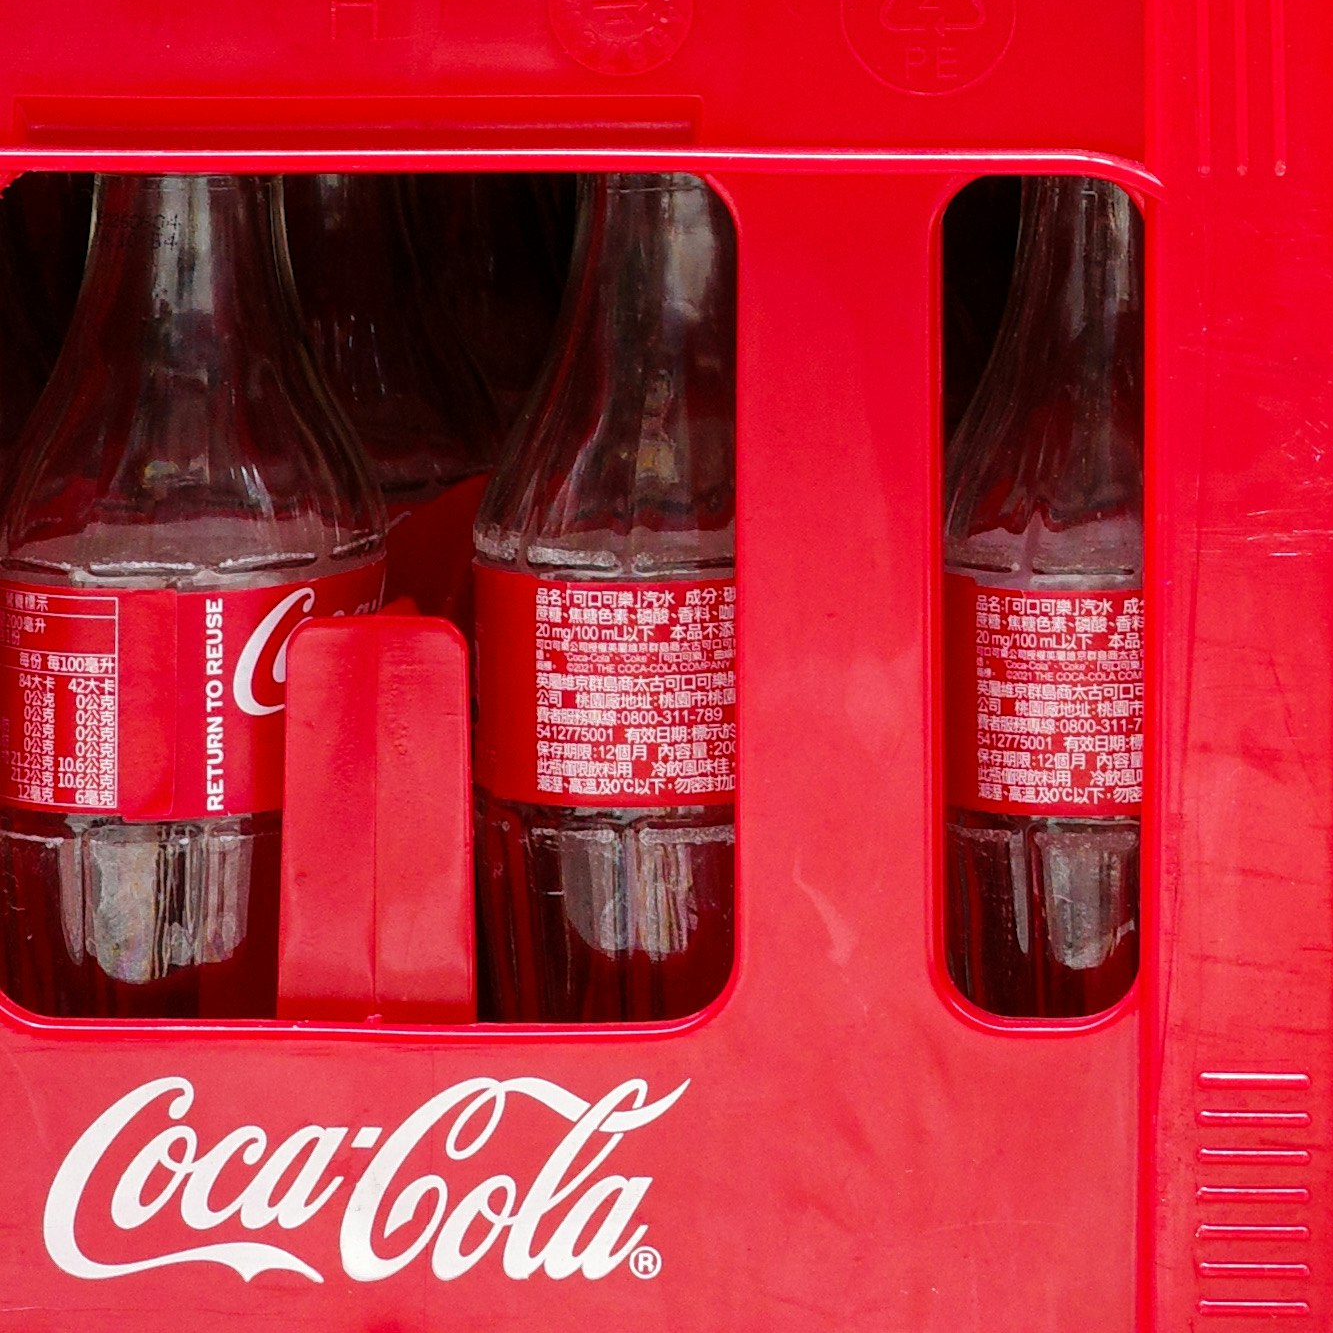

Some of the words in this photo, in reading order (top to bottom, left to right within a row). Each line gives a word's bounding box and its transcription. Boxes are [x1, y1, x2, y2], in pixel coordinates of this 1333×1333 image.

[205, 598, 223, 676] REUSE
[535, 623, 550, 638] 20
[552, 625, 599, 640] mg/100
[602, 625, 655, 642] mL以下
[976, 630, 990, 645] 20
[991, 633, 1037, 649] mg/100
[68, 677, 115, 694] 42大卡
[75, 693, 115, 711] 0公克
[205, 679, 224, 712] TO
[536, 689, 562, 707] 公司
[75, 709, 115, 726] 0公克
[75, 726, 115, 743] 0公克
[537, 724, 614, 742] 5412775001
[75, 742, 115, 758] 0公克
[57, 756, 115, 774] 10.6公克
[206, 721, 224, 812] RETURN
[57, 772, 115, 790] 10.6公克
[44, 1077, 690, 1283] Coca-Cola
